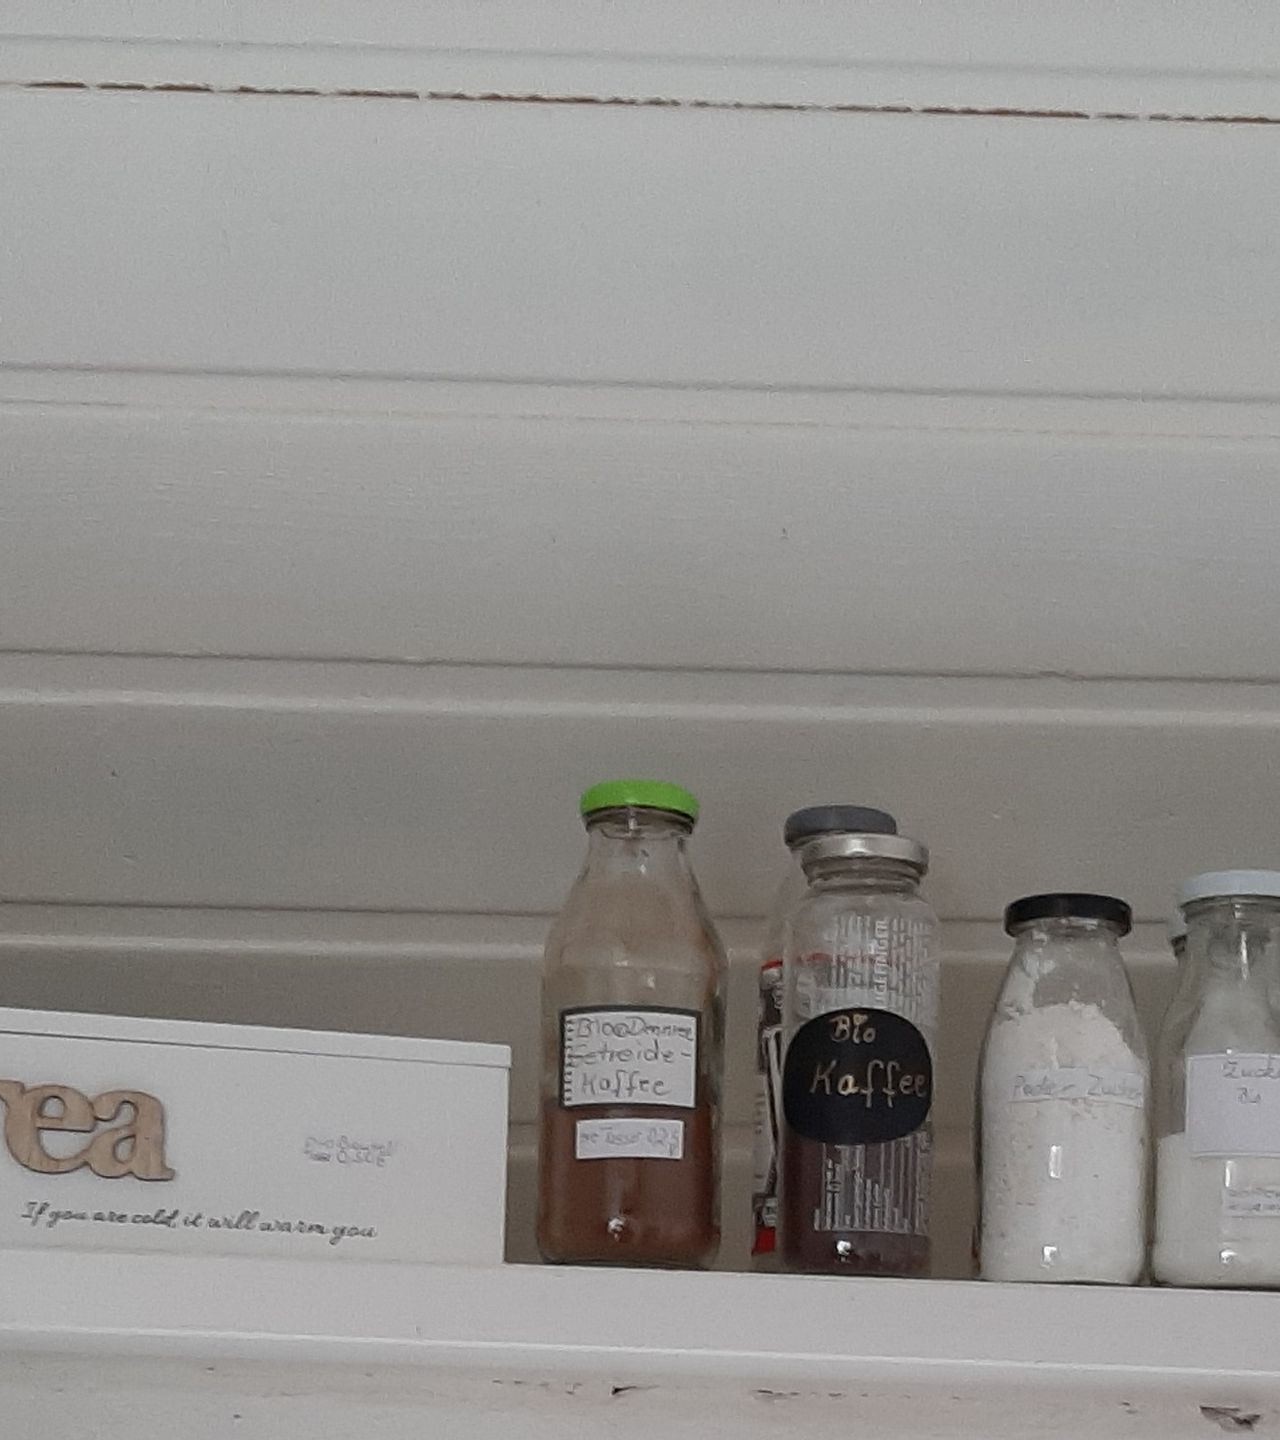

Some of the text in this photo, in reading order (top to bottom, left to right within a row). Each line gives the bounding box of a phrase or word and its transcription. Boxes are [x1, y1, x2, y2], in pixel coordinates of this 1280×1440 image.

[830, 1014, 877, 1044] Bio
[581, 1069, 673, 1098] Kaffee
[809, 1060, 928, 1108] Kaffee
[21, 1201, 50, 1227] If
[47, 1209, 87, 1228] you
[93, 1210, 127, 1224] are
[183, 1211, 203, 1228] it
[208, 1209, 260, 1231] will
[259, 1218, 330, 1237] warm
[331, 1224, 378, 1246] you
